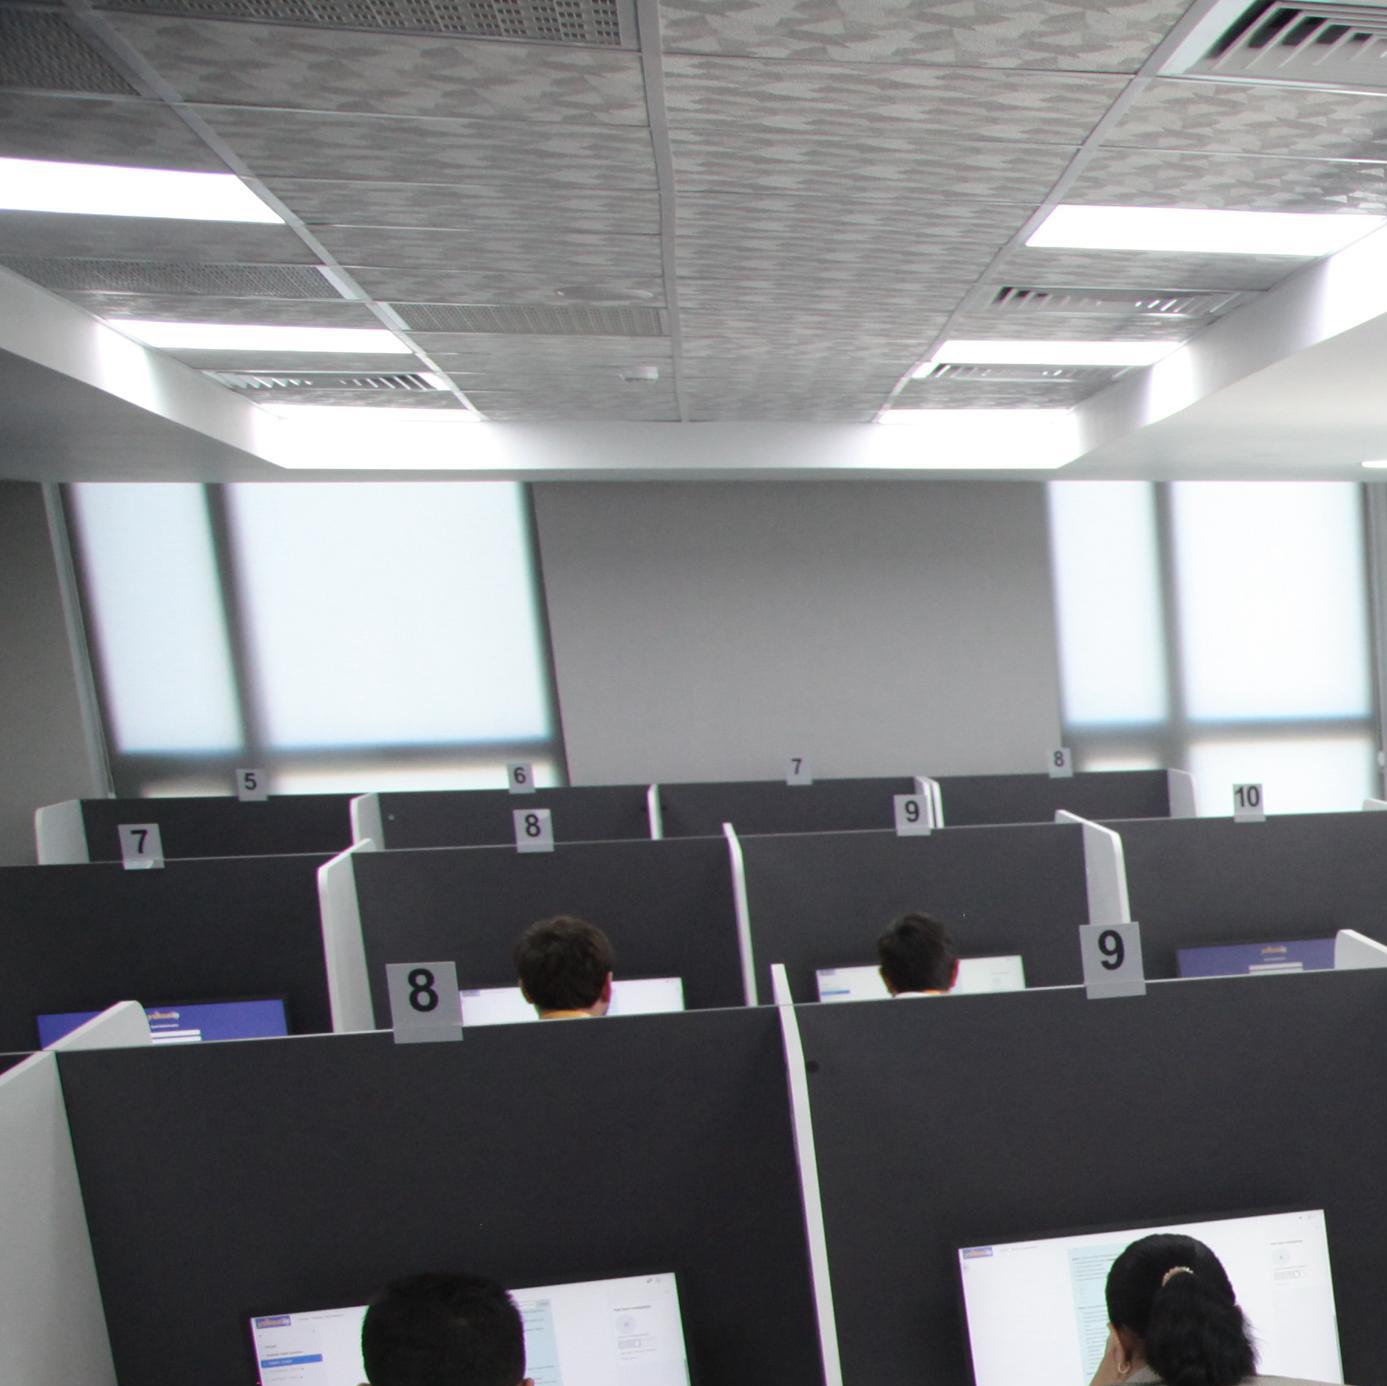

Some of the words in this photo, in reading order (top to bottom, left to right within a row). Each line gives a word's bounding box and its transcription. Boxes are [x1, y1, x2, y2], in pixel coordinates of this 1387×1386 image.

[791, 758, 802, 775] 7
[1054, 750, 1064, 768] 8
[244, 773, 257, 791] 5
[514, 767, 526, 785] 6
[1234, 785, 1260, 808] 10
[905, 800, 919, 824] 9
[524, 814, 541, 838] 8
[131, 829, 148, 855] 7
[1098, 929, 1124, 971] 9
[408, 968, 439, 1012] 8
